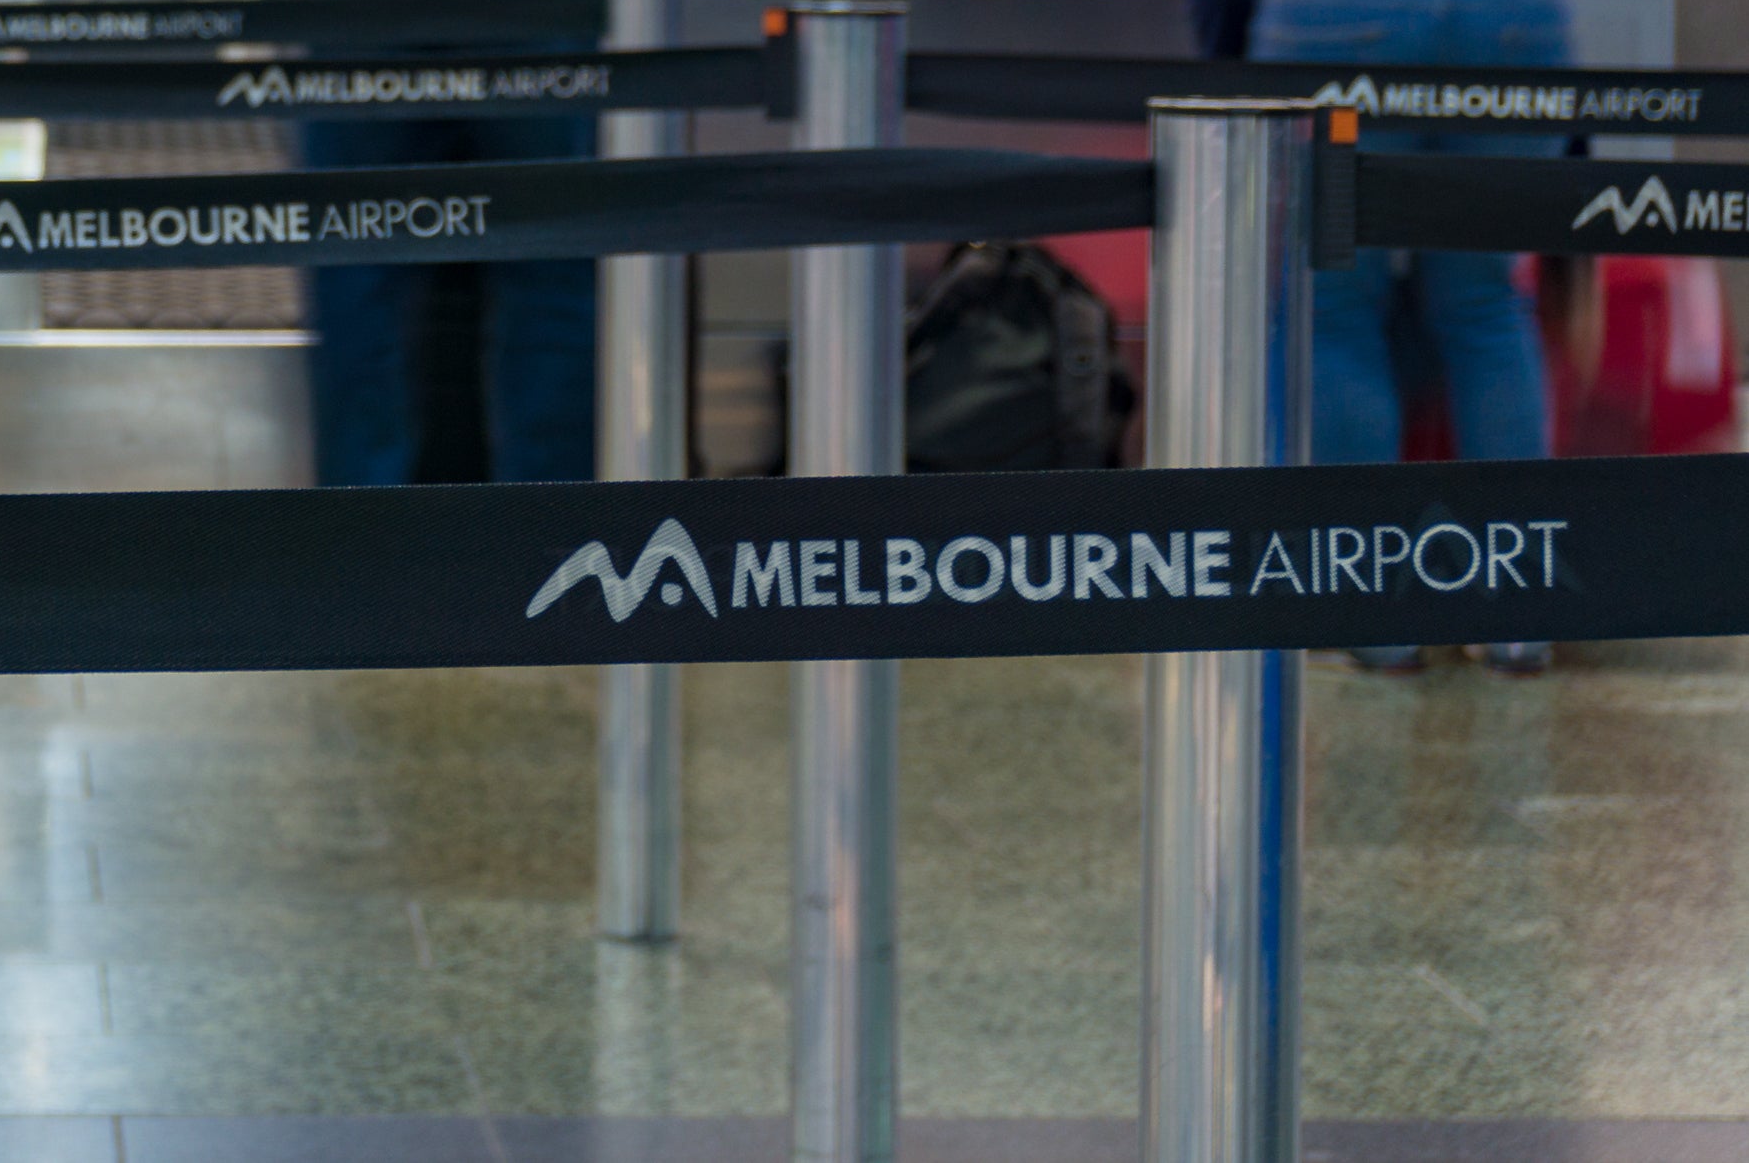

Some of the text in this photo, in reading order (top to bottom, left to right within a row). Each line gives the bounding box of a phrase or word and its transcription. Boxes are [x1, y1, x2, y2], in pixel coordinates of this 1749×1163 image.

[6, 12, 242, 42] MELBOURNE AIRPORT
[296, 66, 610, 104] MELBOURNE AIRPORT
[1384, 85, 1703, 122] MELBOURNE AIRPORT
[39, 196, 491, 250] MELBOURNE AIRPORT
[732, 521, 1569, 609] MELBOURNE AIRPORT
